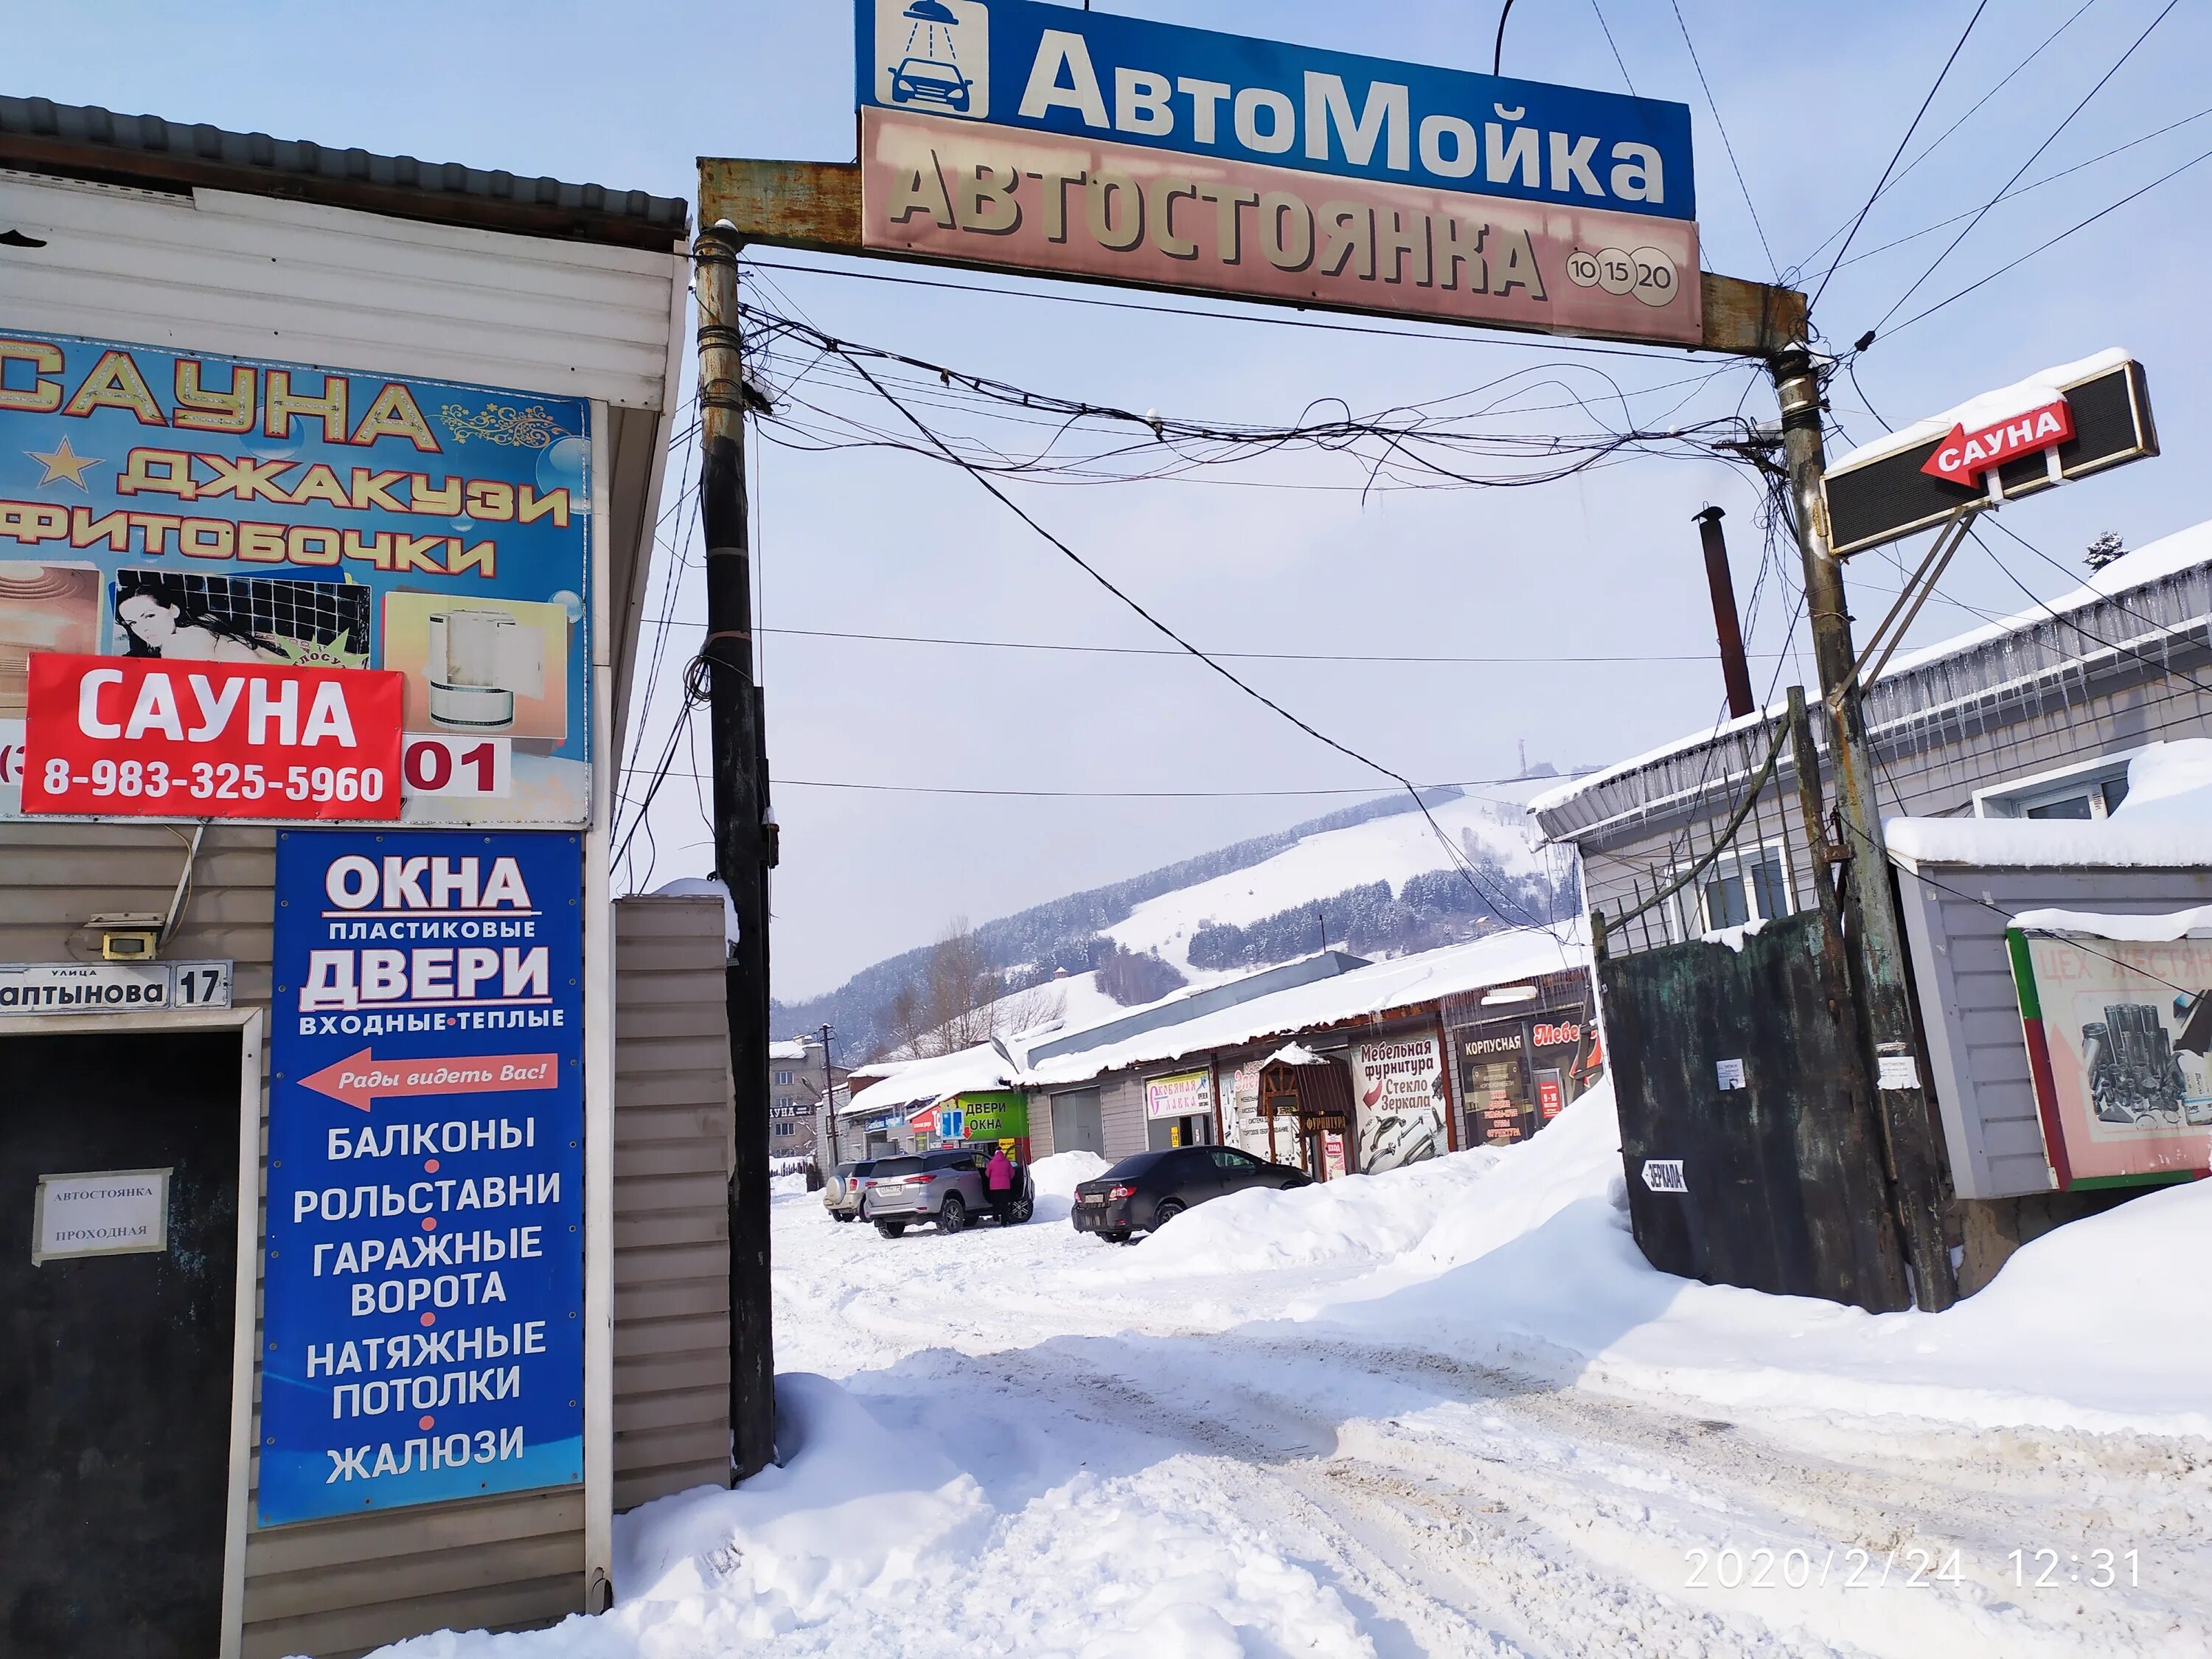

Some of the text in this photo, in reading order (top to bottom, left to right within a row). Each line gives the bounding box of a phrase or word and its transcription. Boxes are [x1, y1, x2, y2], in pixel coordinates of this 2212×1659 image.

[1018, 29, 1664, 204] АвтоМойка
[890, 147, 1548, 301] АВТОСТОЯНКА
[1571, 260, 1671, 289] 10 15 20
[0, 338, 443, 453] САУНА
[1937, 411, 2062, 473] САУНА
[116, 447, 571, 528] ДЖАКУЗИ
[0, 499, 498, 579] ФИТОБОЧКИ
[77, 668, 358, 748] САУНА
[44, 757, 384, 802] 8-983-325-5960
[325, 855, 532, 909] ОКНА
[329, 921, 535, 940] ПЛАСТИКОВЫЕ
[52, 969, 97, 978] УЛИЦА
[180, 970, 220, 1004] 17
[299, 947, 549, 1012] ДВЕРИ
[2039, 949, 2092, 988] ЦЕХ
[299, 1009, 564, 1036] ВХОДНЫЕ ТЕПЛЫЕ
[1361, 1040, 1431, 1062] Мебельная
[1465, 1035, 1521, 1055] КОРПУСНАЯ
[338, 1063, 547, 1089] Рады видеть Вас!
[1365, 1057, 1433, 1081] фурнитура
[1386, 1079, 1427, 1094] Стекло
[966, 1102, 1006, 1116] ДВЕРИ
[1306, 1116, 1346, 1130] ФУРНИТУРА
[1382, 1095, 1430, 1114] Зеркала
[327, 1117, 535, 1160] БАЛКОНЫ
[970, 1119, 1002, 1130] ОКНА
[53, 1187, 153, 1202] АВТОСТОЯНКА
[1649, 1164, 1683, 1188] ЗЕРКАЛА
[294, 1172, 560, 1223] РОЛЬСТАВНИ
[55, 1225, 147, 1242] ПРОХОДНАЯ
[313, 1225, 543, 1276] ГАРАЖНЫЕ
[351, 1270, 507, 1317] ВОРОТА
[307, 1321, 546, 1378] НАТЯЖНЫЕ
[333, 1366, 520, 1419] ПОТОЛКИ
[325, 1426, 524, 1484] ЖАЛЮЗИ
